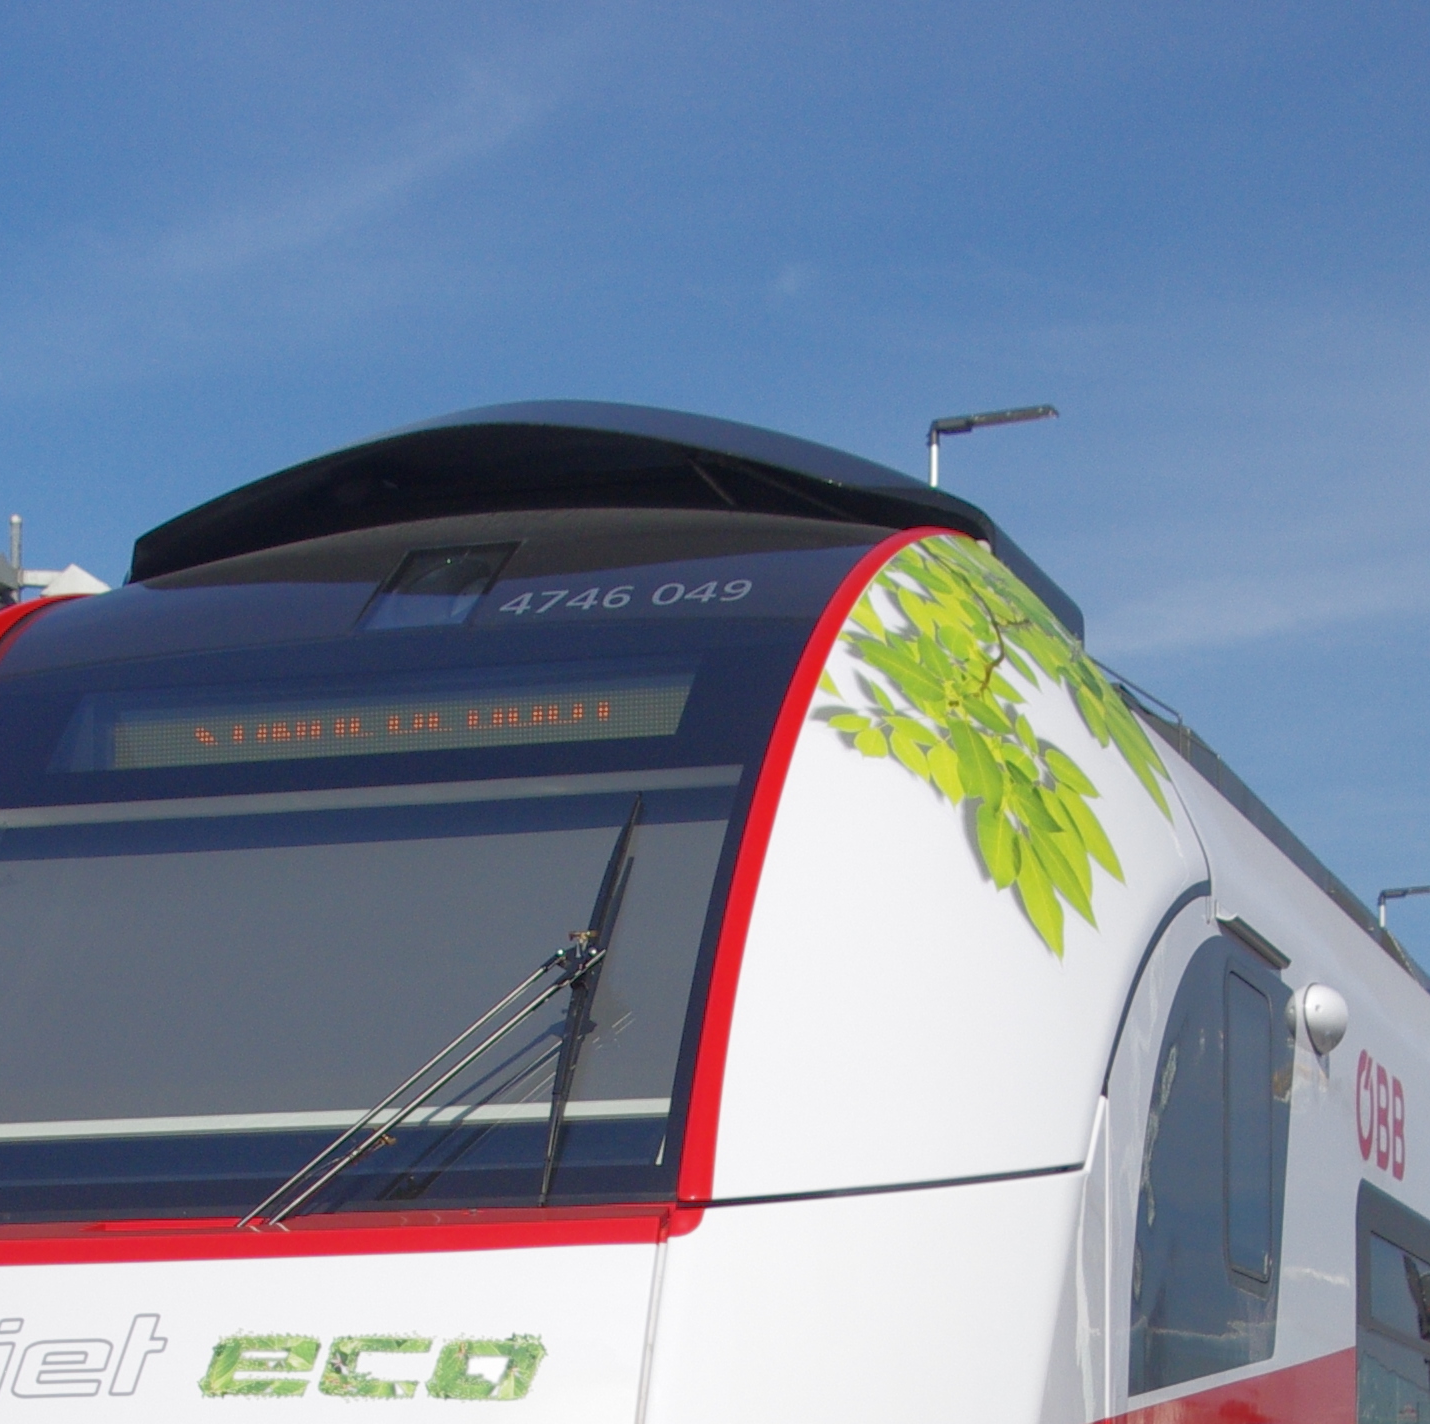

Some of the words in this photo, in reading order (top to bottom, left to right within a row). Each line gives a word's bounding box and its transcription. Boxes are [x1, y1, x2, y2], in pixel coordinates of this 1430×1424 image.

[499, 585, 634, 616] 4746
[651, 579, 753, 606] 049
[1356, 1048, 1405, 1182] ÖBB
[198, 1332, 548, 1401] eco
